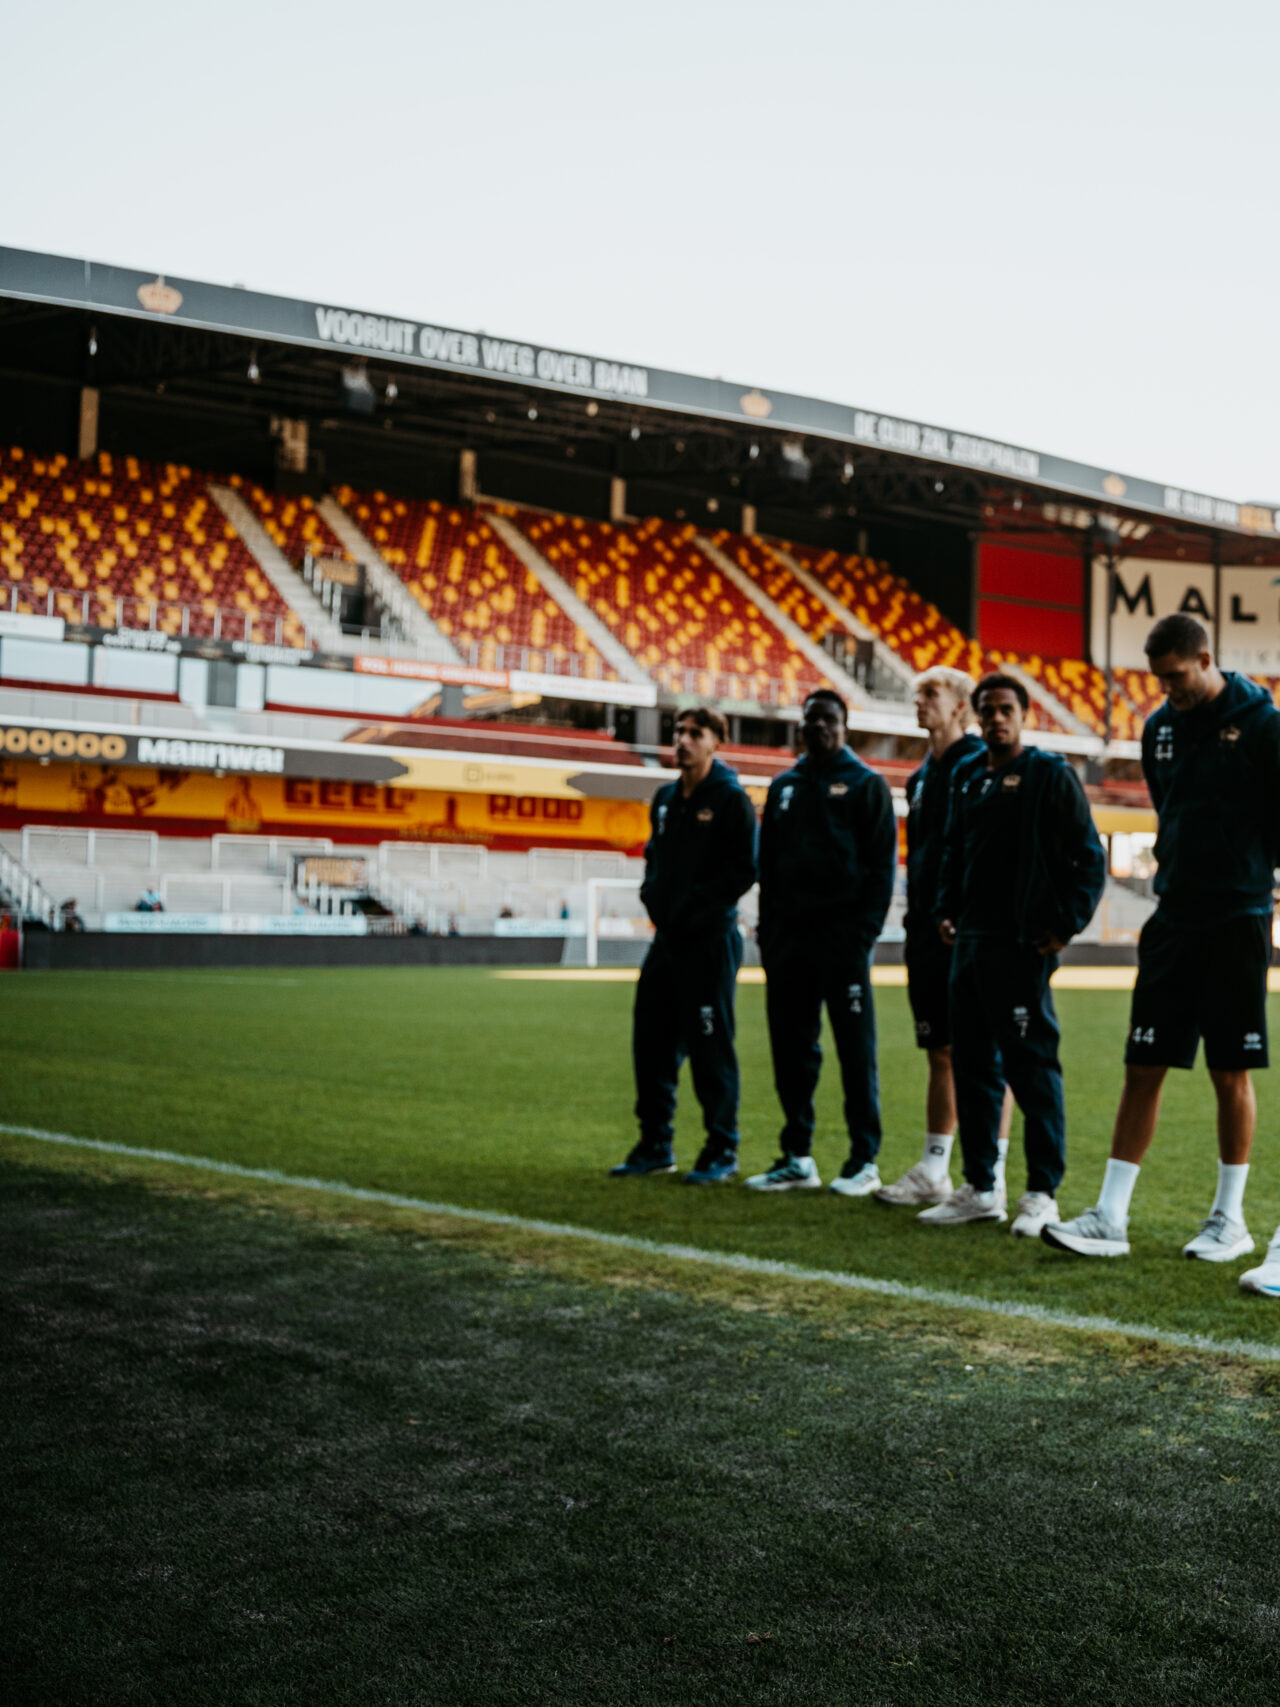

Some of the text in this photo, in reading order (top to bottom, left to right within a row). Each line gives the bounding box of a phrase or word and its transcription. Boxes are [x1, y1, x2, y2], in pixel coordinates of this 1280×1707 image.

[315, 305, 417, 355] VOORUIT
[419, 326, 480, 366] OVER
[481, 337, 536, 377] WEG
[537, 348, 592, 388] OVER
[1154, 742, 1174, 761] 44
[1131, 1025, 1155, 1045] 44
